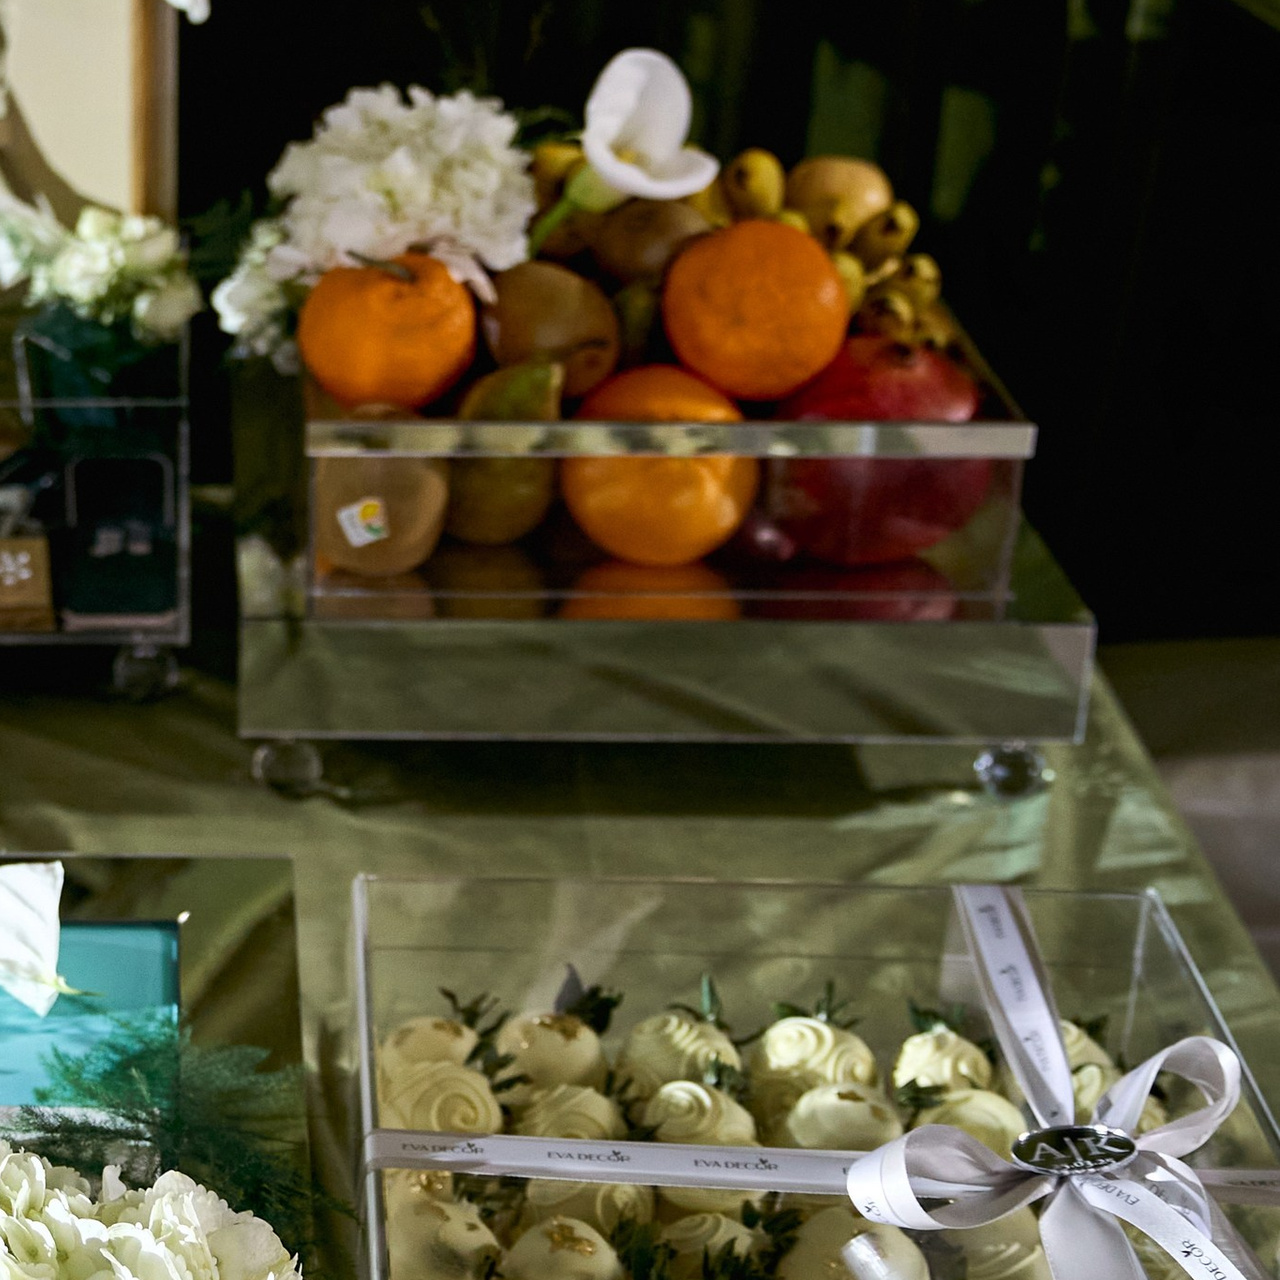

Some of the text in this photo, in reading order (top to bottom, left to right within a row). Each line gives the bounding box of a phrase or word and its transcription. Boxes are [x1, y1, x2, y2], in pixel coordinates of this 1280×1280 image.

[401, 1143, 485, 1154] EVA DECOR
[547, 1151, 631, 1163] EVA DECOR
[693, 1158, 779, 1171] EVA DECOR
[1116, 1189, 1140, 1206] EVA
